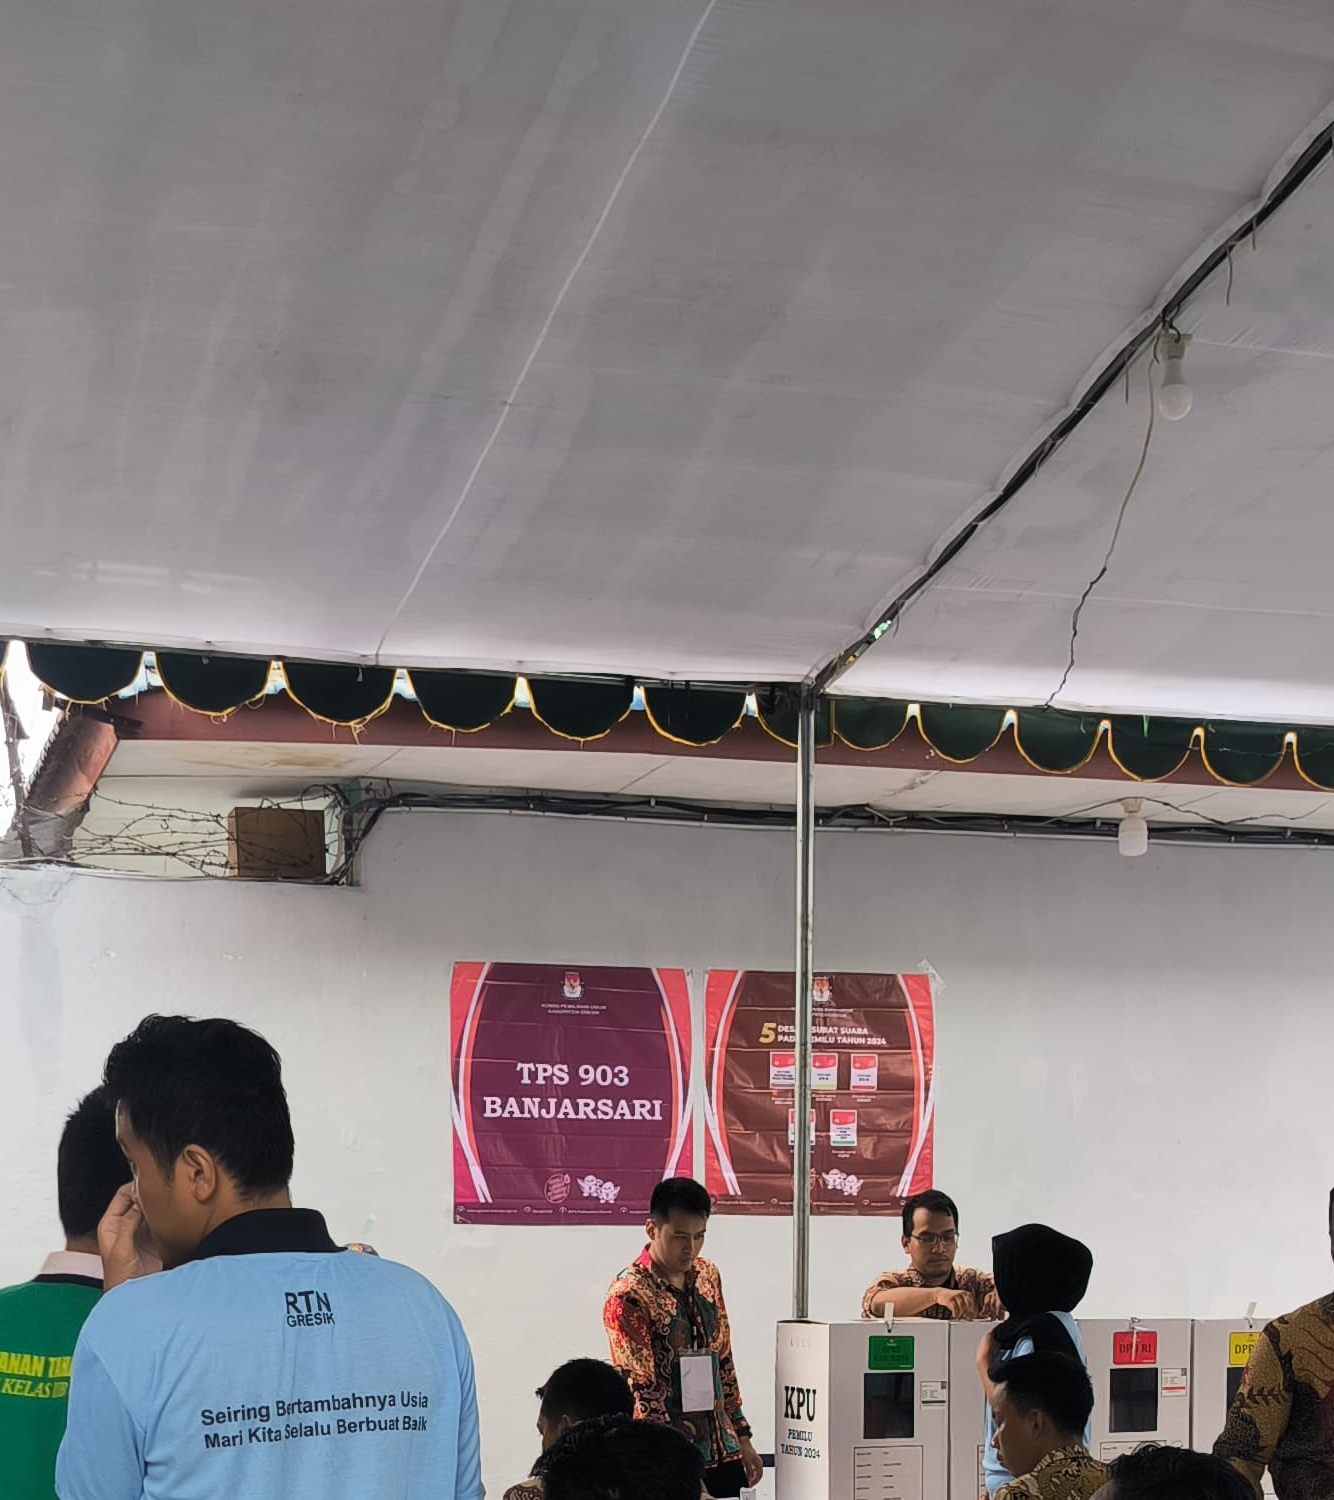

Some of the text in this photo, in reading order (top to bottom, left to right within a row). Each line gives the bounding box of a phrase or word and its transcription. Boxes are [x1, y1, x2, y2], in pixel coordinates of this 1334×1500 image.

[758, 1022, 777, 1044] 5
[839, 1026, 869, 1036] SUARA
[777, 1034, 796, 1044] PAD
[810, 1035, 835, 1045] EMILU
[836, 1036, 865, 1046] TAHUN
[516, 1062, 630, 1087] TPS 903
[482, 1095, 664, 1121] BANJARSARI
[284, 1290, 332, 1315] RTN
[286, 1312, 336, 1328] GRESIK
[1, 1377, 52, 1398] KELAS
[200, 1390, 429, 1426] Seiring Bertambahnya Usia
[783, 1385, 817, 1422] KPU
[204, 1415, 428, 1449] Mari Kita Selalu Berbuat Baik
[787, 1428, 813, 1442] PEMILU
